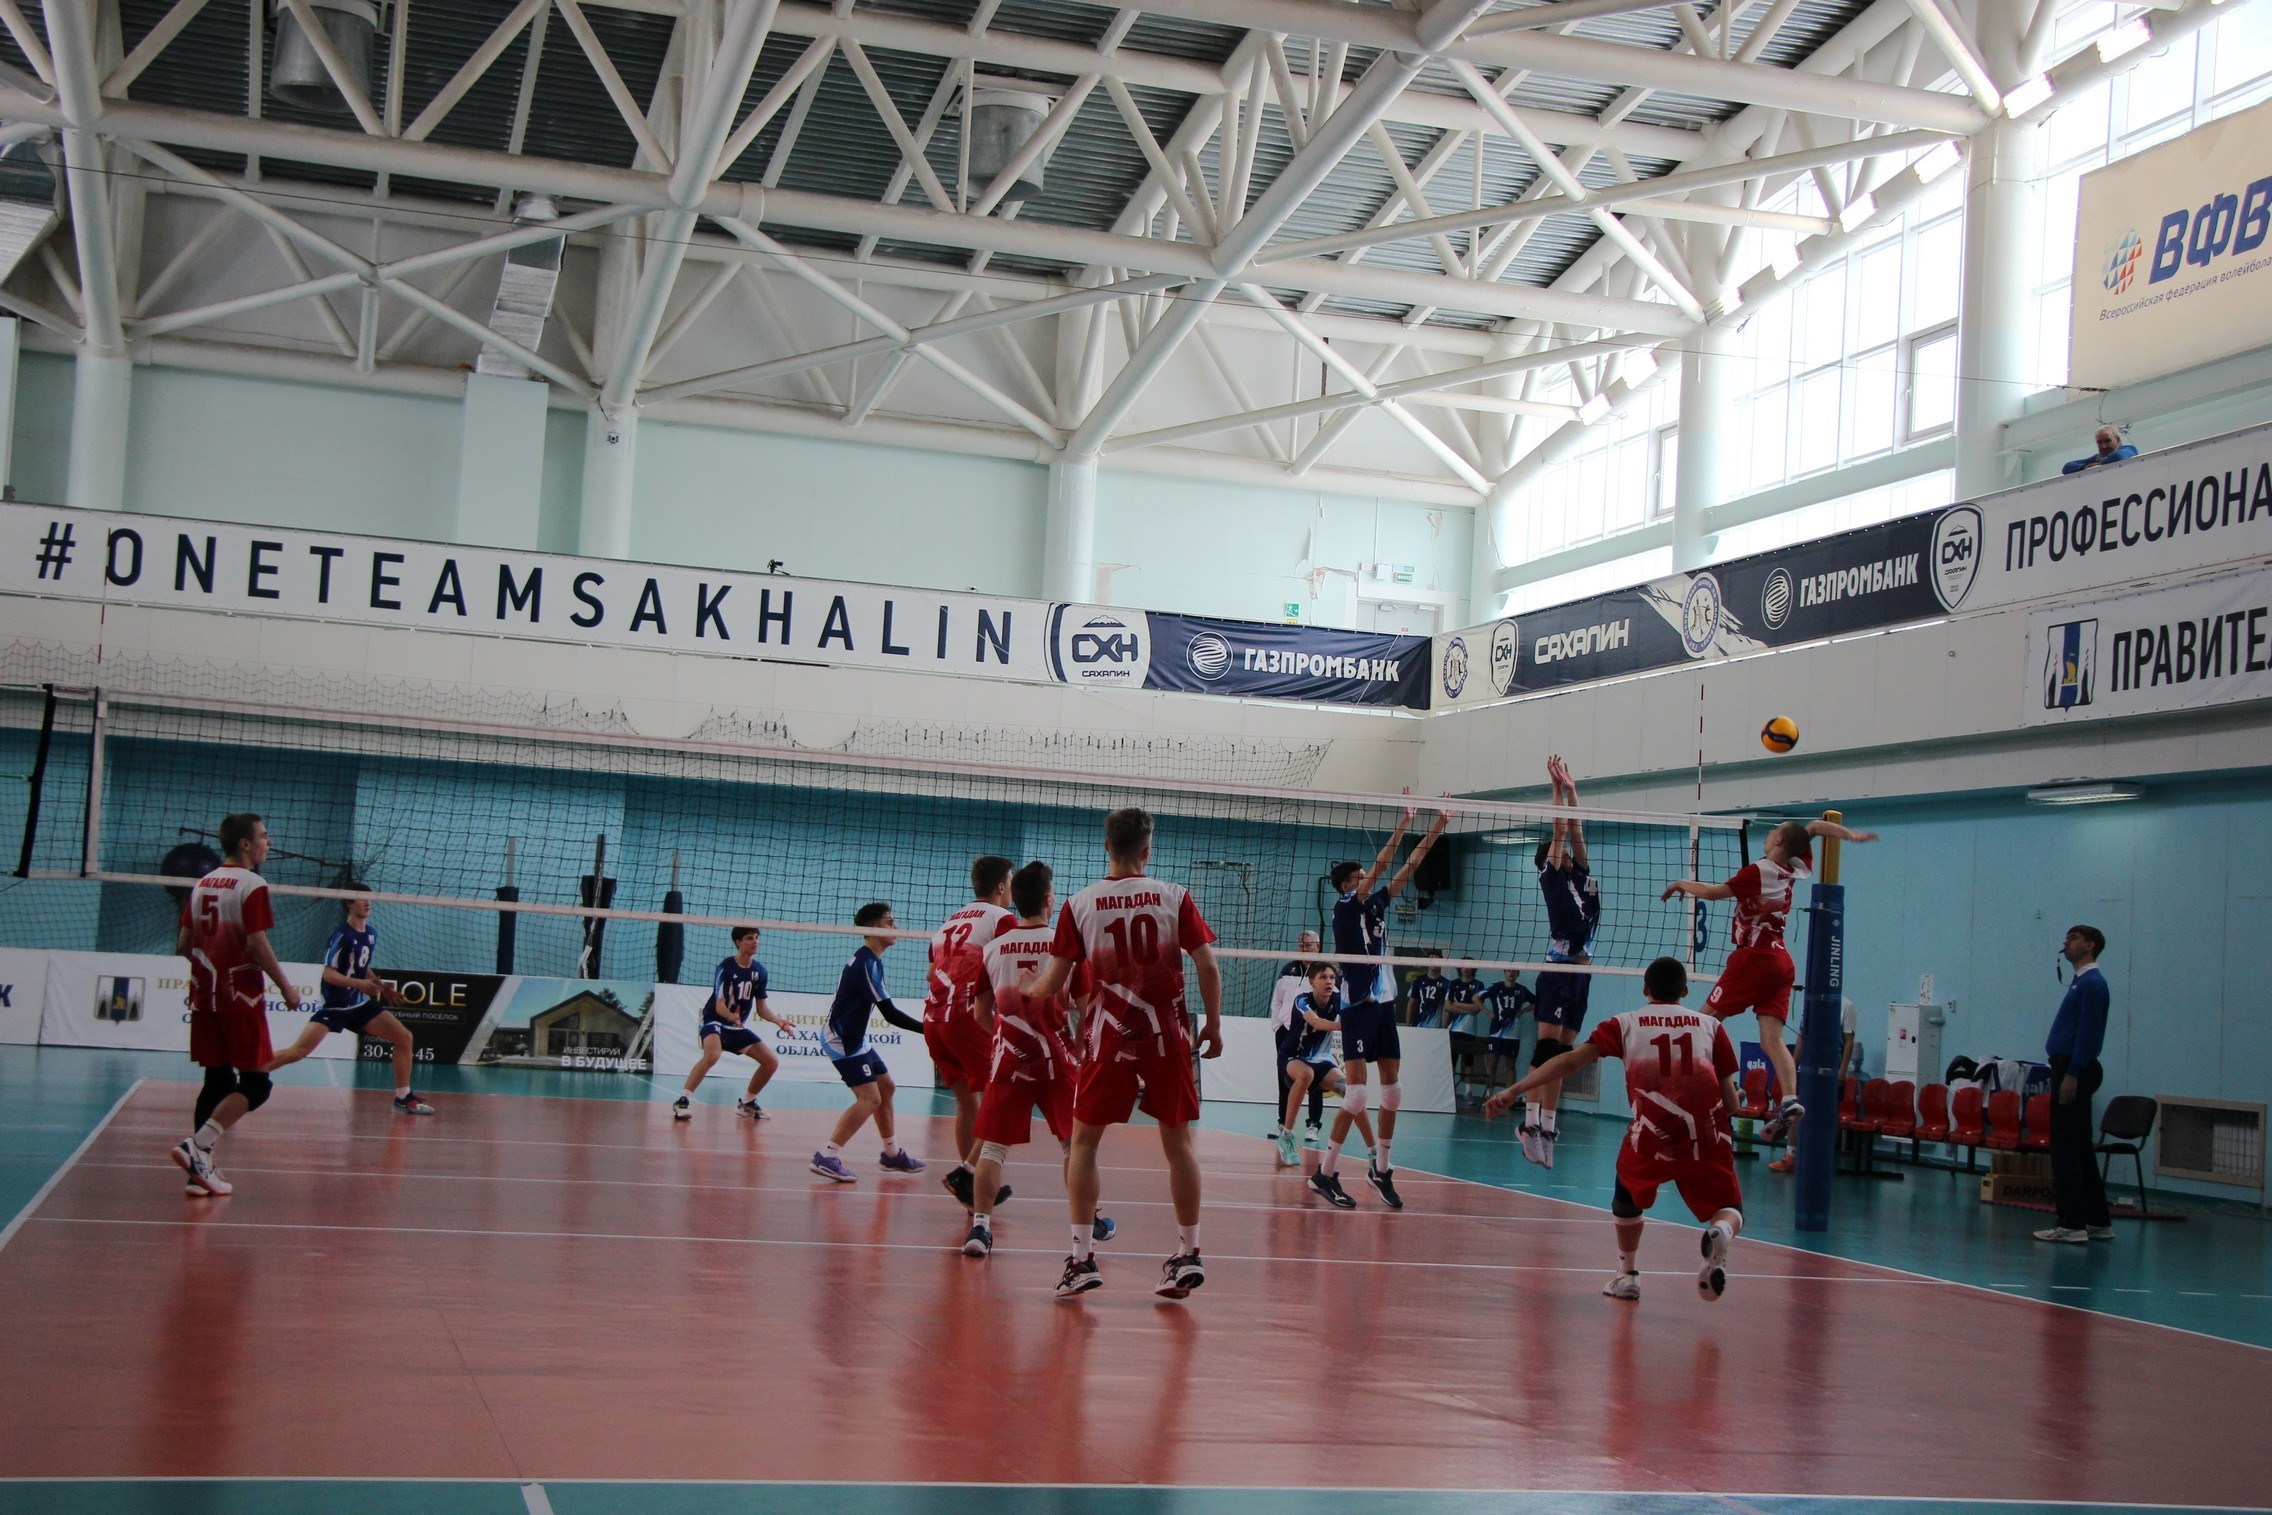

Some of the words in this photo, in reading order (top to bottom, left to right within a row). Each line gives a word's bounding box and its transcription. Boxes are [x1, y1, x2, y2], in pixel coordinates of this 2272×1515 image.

[2148, 175, 2272, 285] ВФВ
[2099, 293, 2164, 321] Всероссийская
[2166, 275, 2218, 302] федерация
[1800, 553, 1919, 608] ГАЗПРОМБАНК
[2111, 606, 2272, 692] ПРАВИТЕ
[1244, 648, 1400, 682] ГАЗПРОМБАНК
[201, 895, 219, 936] 5
[1096, 892, 1161, 911] МАГАДАН
[943, 923, 973, 958] 12
[1104, 914, 1160, 967] 10
[359, 946, 370, 968] 8
[1830, 936, 1841, 987] JINLING
[738, 981, 752, 1000] 10
[1710, 986, 1723, 1004] 9
[1554, 1007, 1563, 1019] 4
[1638, 1016, 1700, 1028] МАГАДАН
[563, 1046, 620, 1055] ИНВЕСТИРУЙ
[1357, 1039, 1364, 1053] 3
[1650, 1032, 1693, 1077] 11
[561, 1056, 571, 1067] В
[575, 1057, 647, 1070] БУДУЩЕЕ
[862, 1064, 872, 1077] 9
